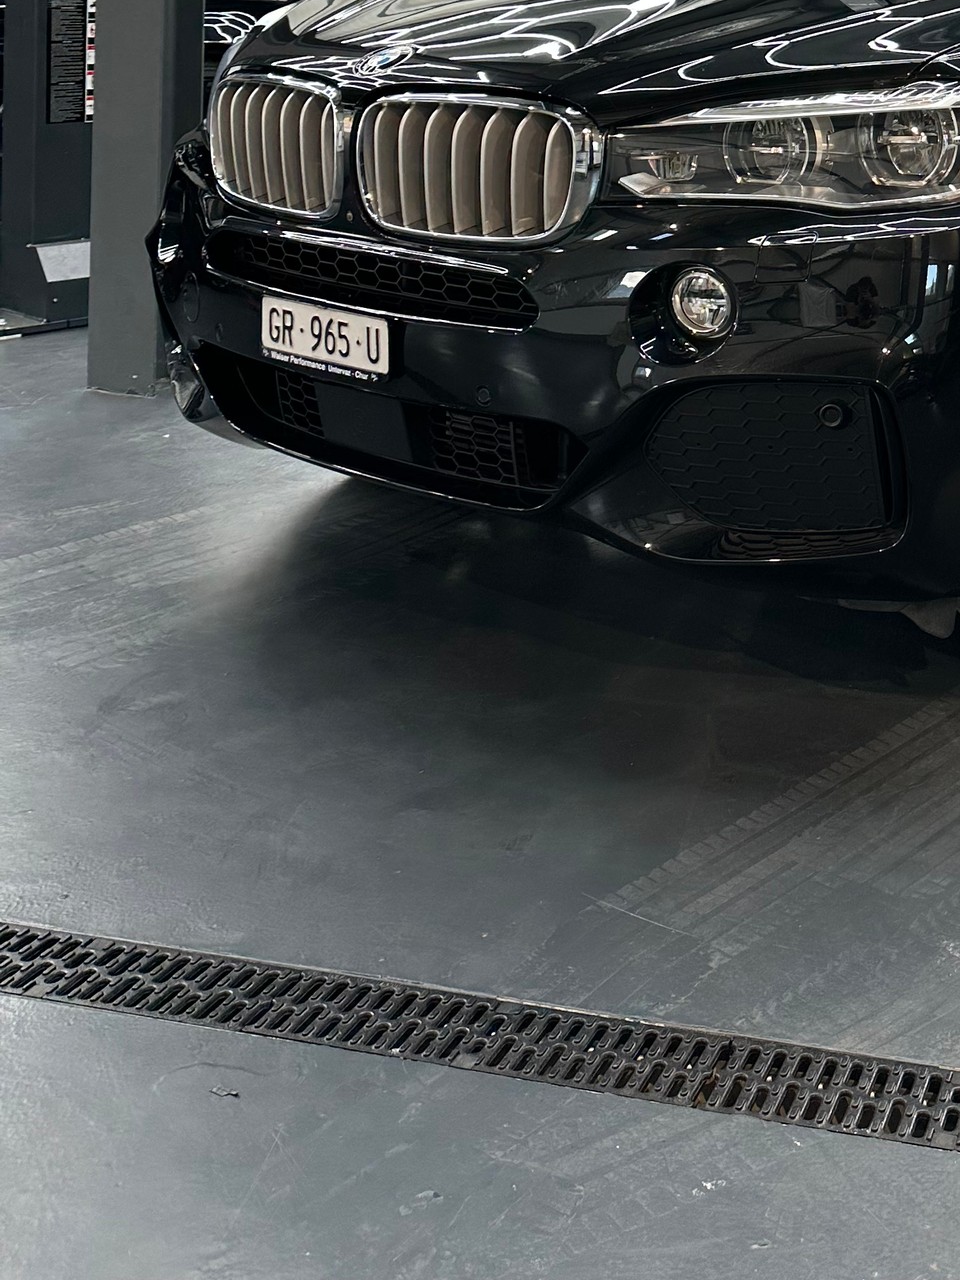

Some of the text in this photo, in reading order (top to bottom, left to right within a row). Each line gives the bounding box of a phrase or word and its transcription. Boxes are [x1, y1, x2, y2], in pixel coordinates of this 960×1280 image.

[269, 307, 294, 347] GR
[310, 315, 350, 358] 965
[366, 326, 380, 365] U
[290, 355, 326, 371] Performance
